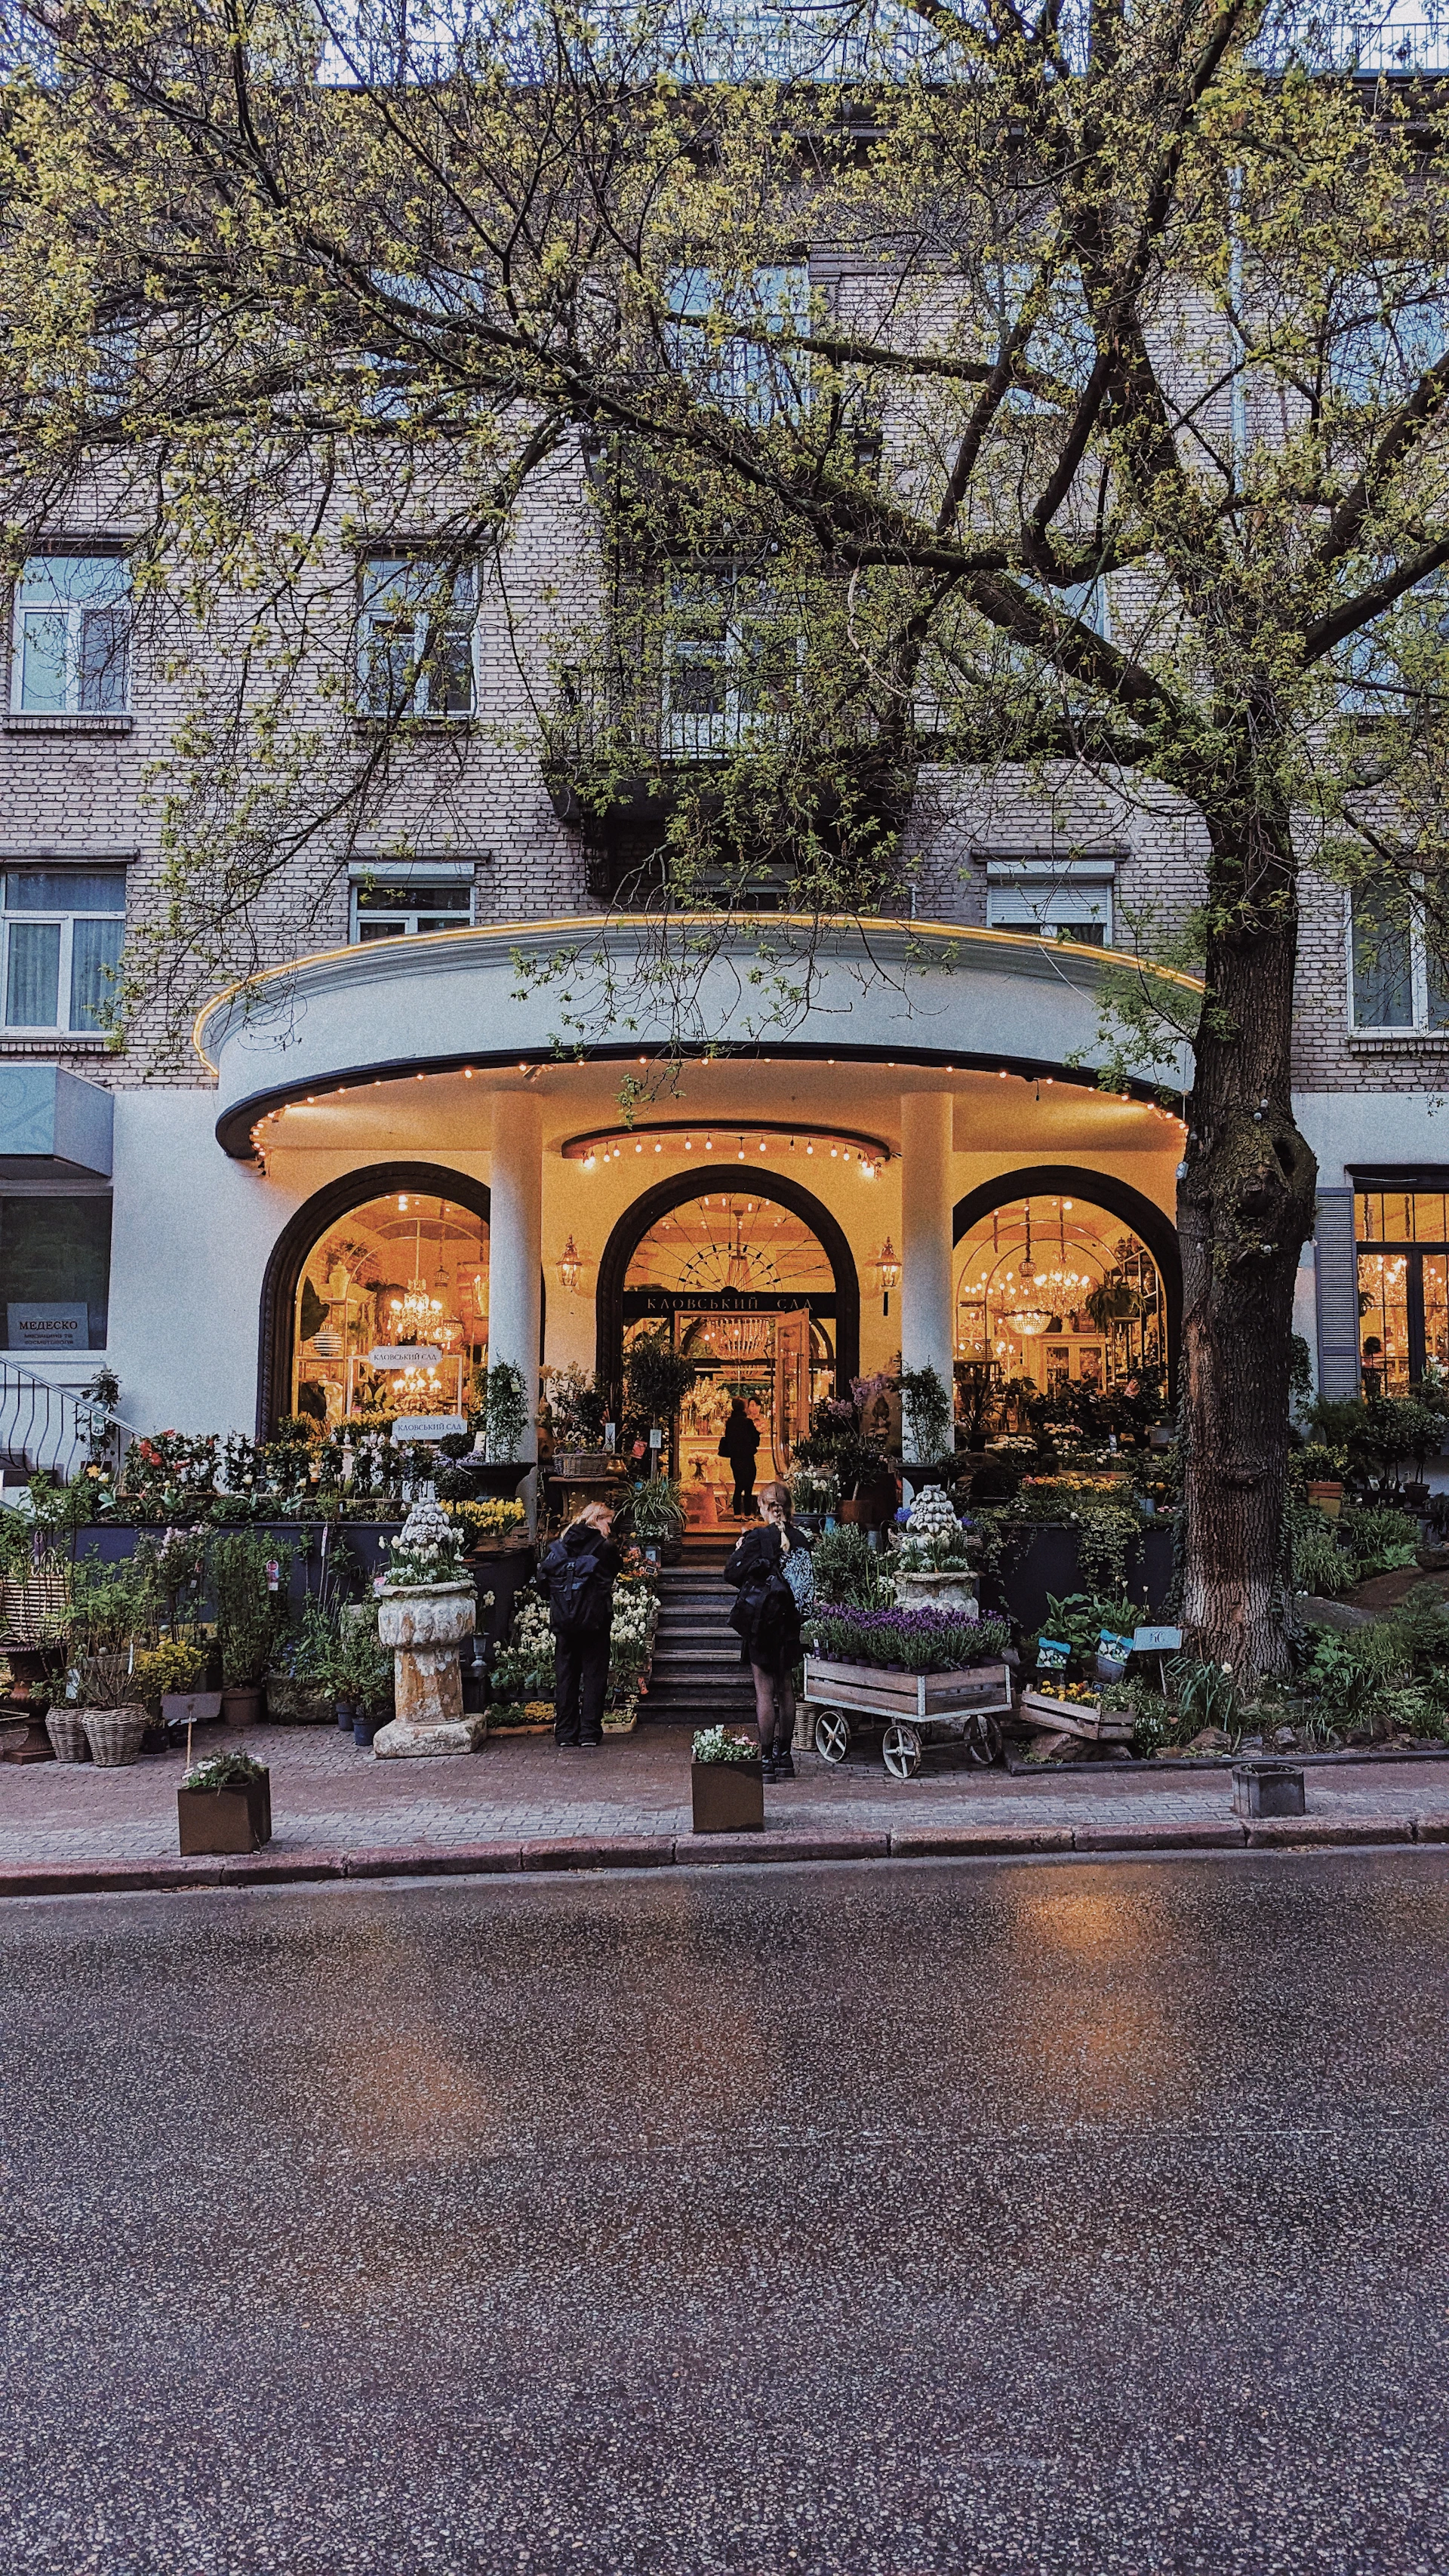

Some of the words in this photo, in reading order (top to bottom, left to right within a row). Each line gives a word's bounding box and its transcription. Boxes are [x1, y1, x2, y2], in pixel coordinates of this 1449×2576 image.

[648, 1297, 758, 1309] КЛОВСЬКИЙ
[777, 1298, 813, 1310] САД
[19, 1322, 77, 1330] МЕДЕСКО
[398, 1423, 445, 1431] КЛОВСЬКИЙ
